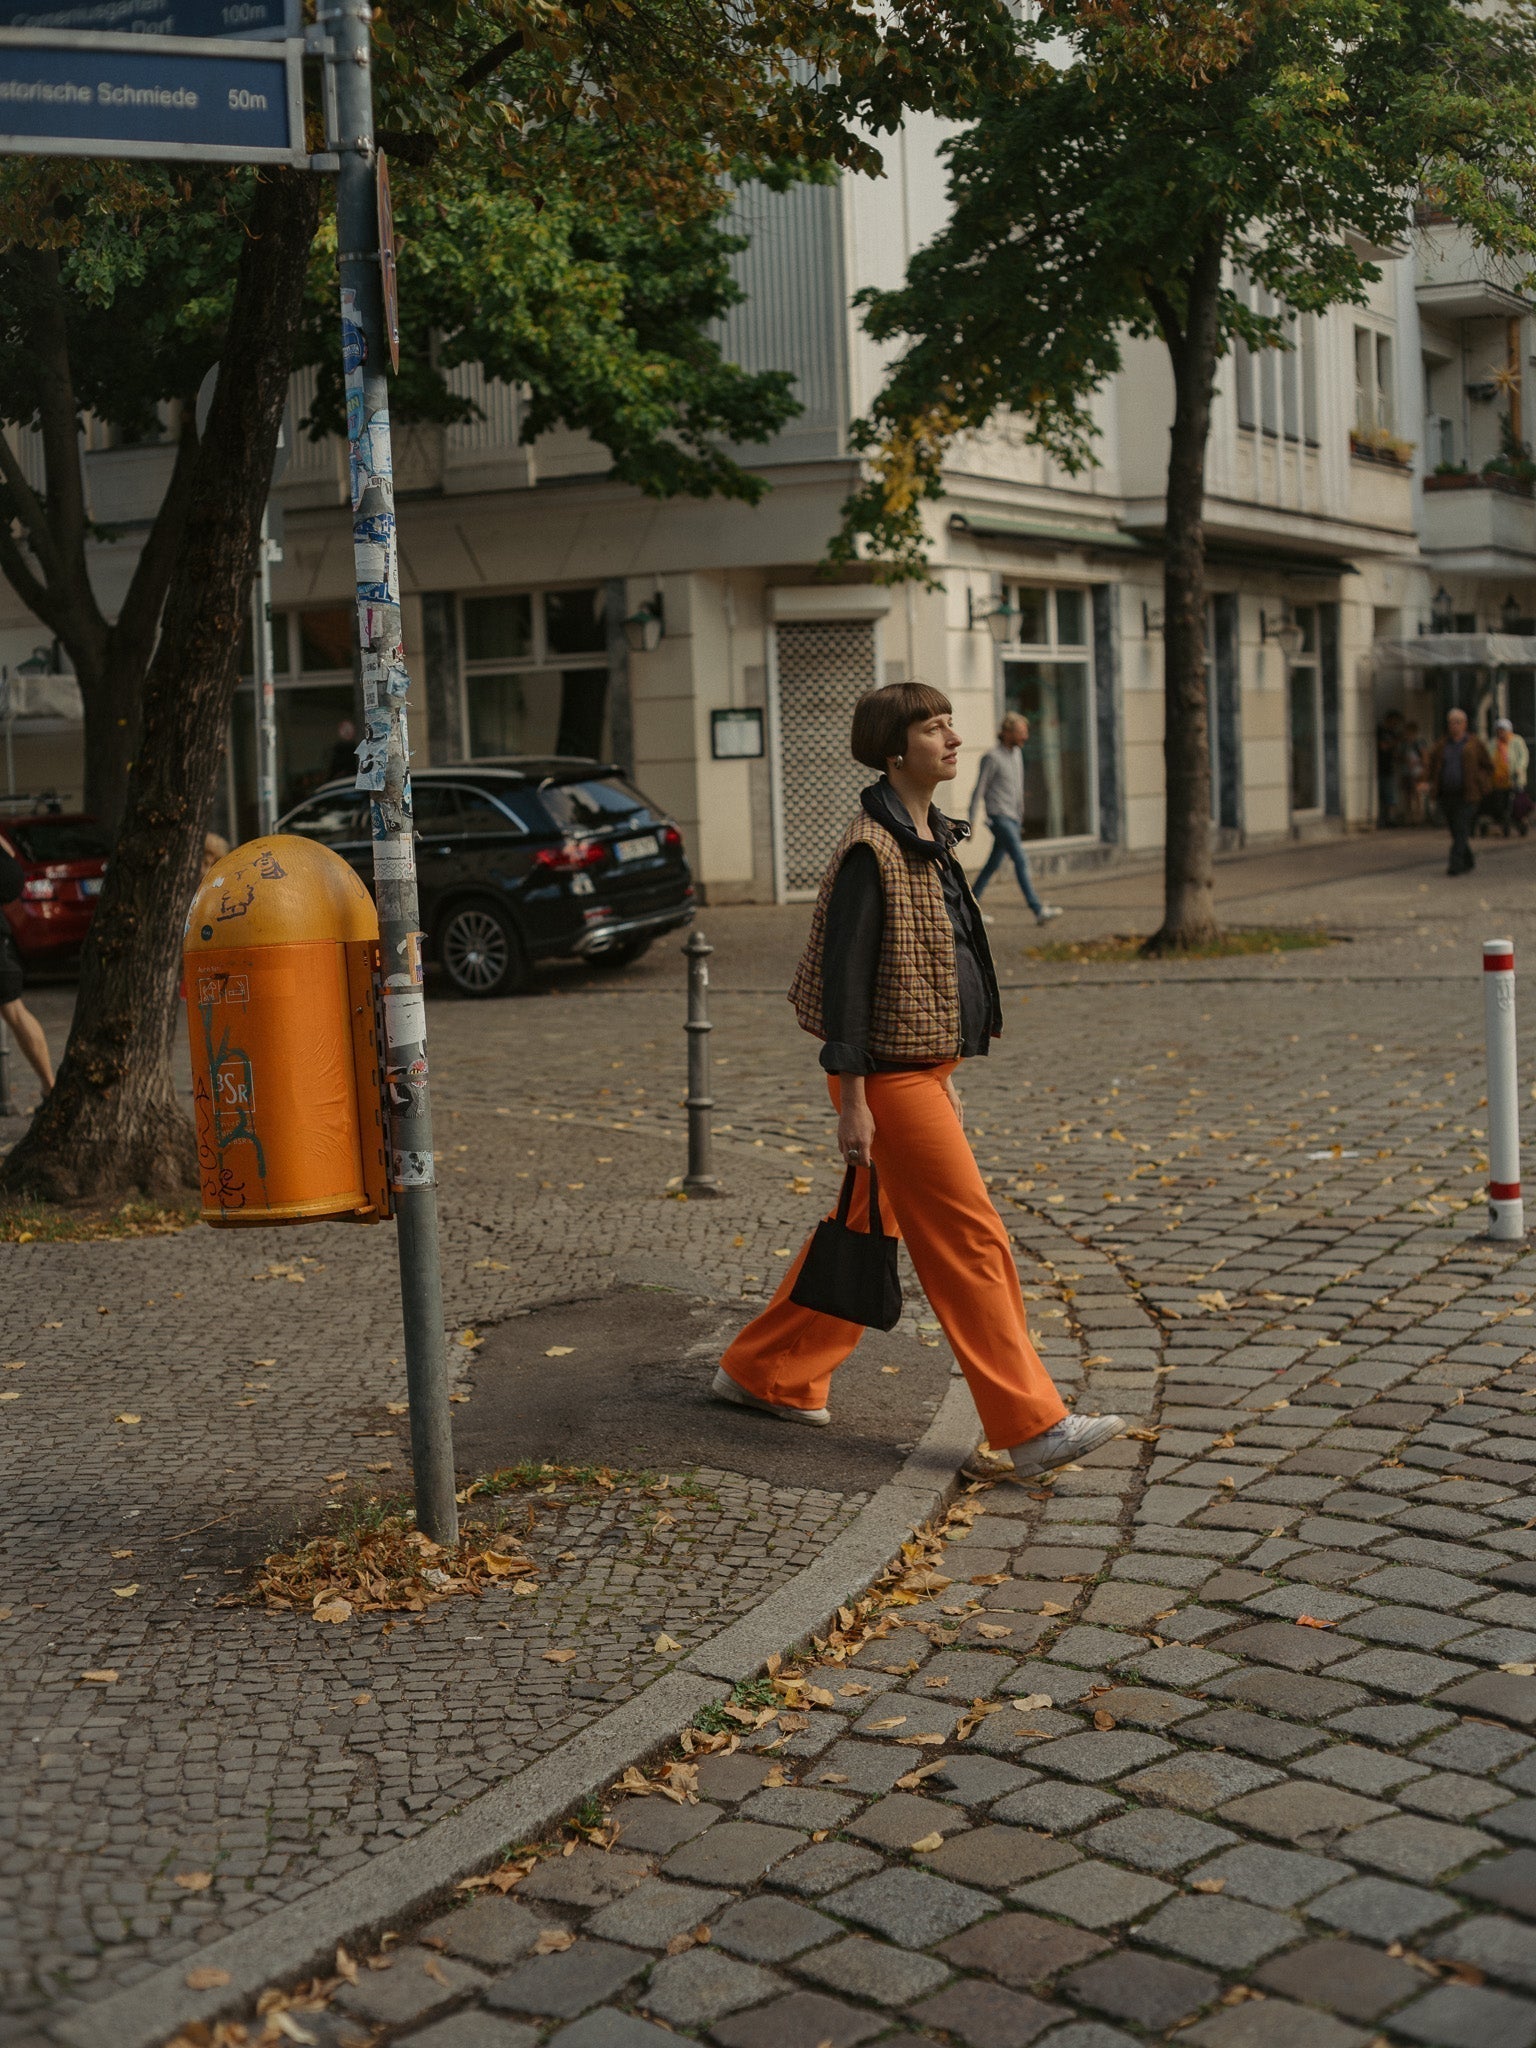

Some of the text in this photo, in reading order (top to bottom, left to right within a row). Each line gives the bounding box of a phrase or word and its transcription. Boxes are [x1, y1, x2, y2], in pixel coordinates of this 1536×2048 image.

[223, 3, 266, 25] 100m
[97, 81, 199, 108] Schmiede
[228, 88, 267, 110] 50m
[215, 1072, 248, 1104] BSR
